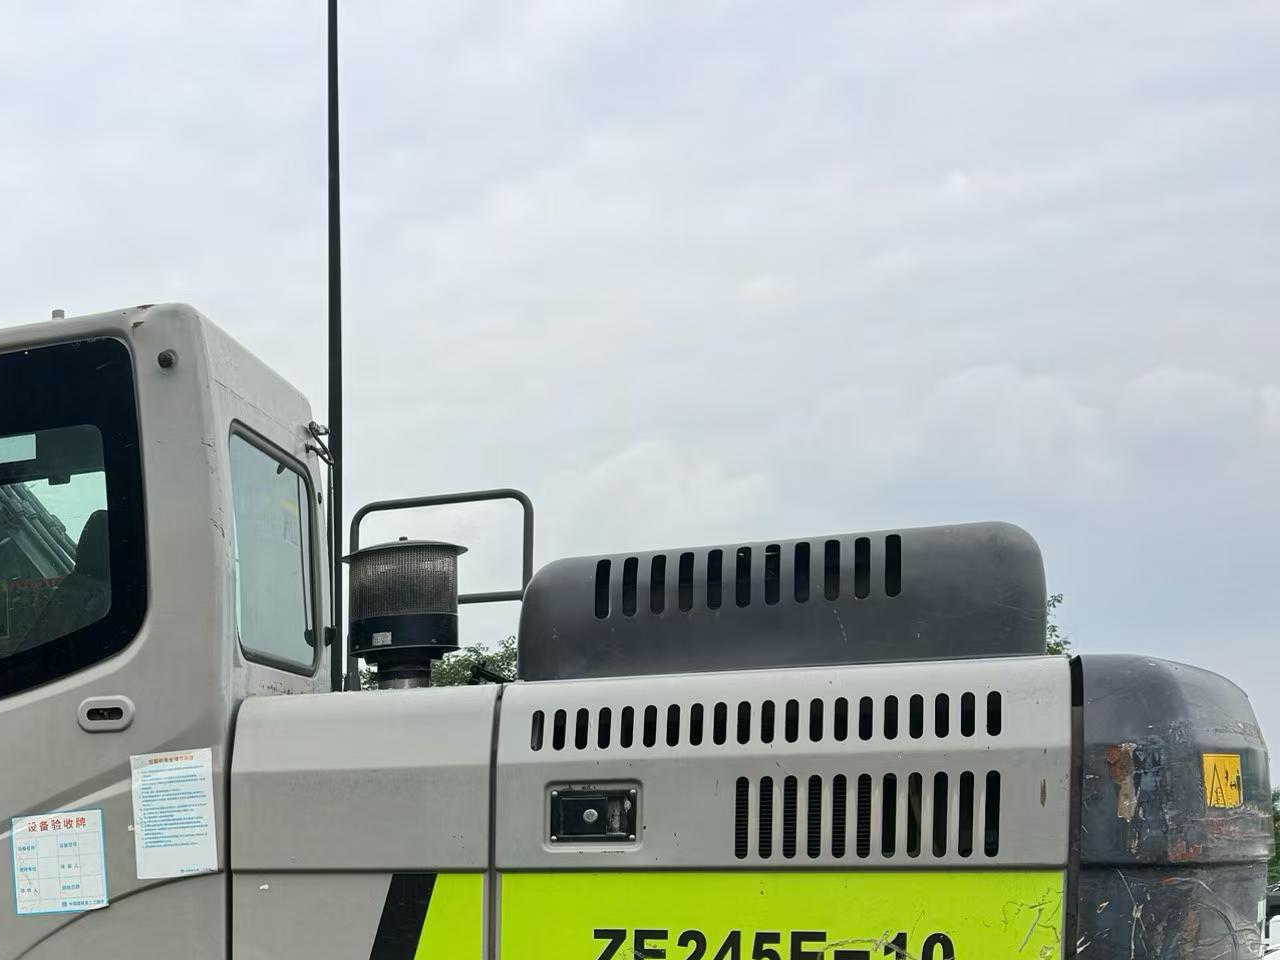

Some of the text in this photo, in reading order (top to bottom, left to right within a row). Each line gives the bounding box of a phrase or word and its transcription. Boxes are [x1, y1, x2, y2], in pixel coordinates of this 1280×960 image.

[27, 817, 86, 833] 设备验收牌
